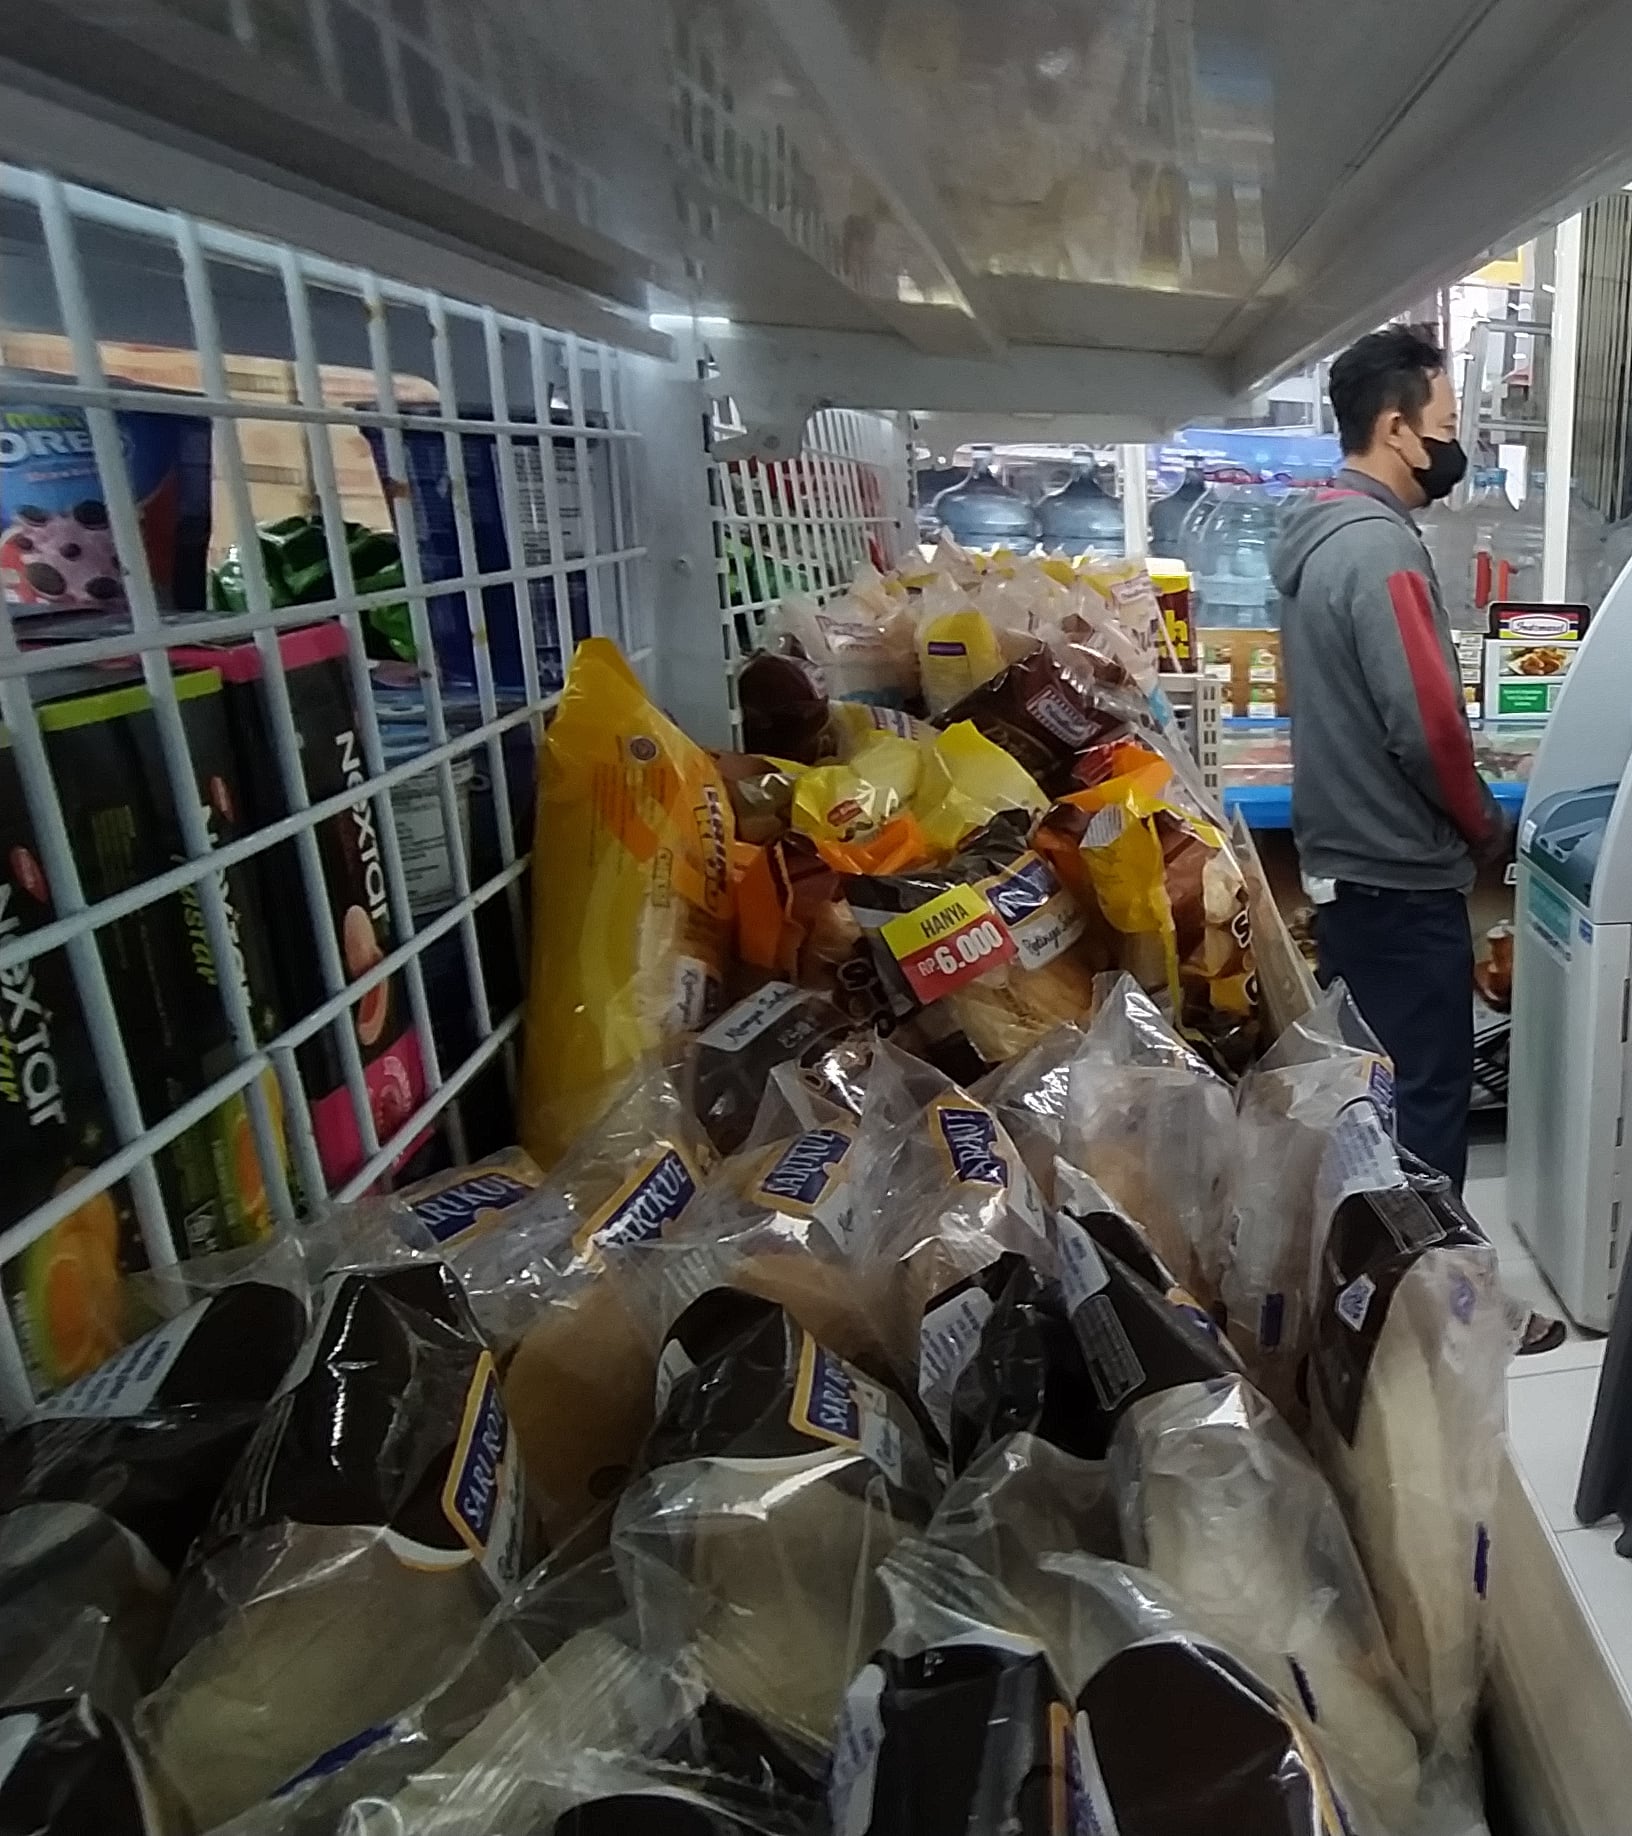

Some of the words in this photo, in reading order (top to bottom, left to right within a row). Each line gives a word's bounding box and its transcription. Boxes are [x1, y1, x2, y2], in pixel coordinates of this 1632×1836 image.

[0, 430, 96, 464] ORE
[920, 901, 970, 939] HANYA
[934, 920, 1004, 976] 6.000
